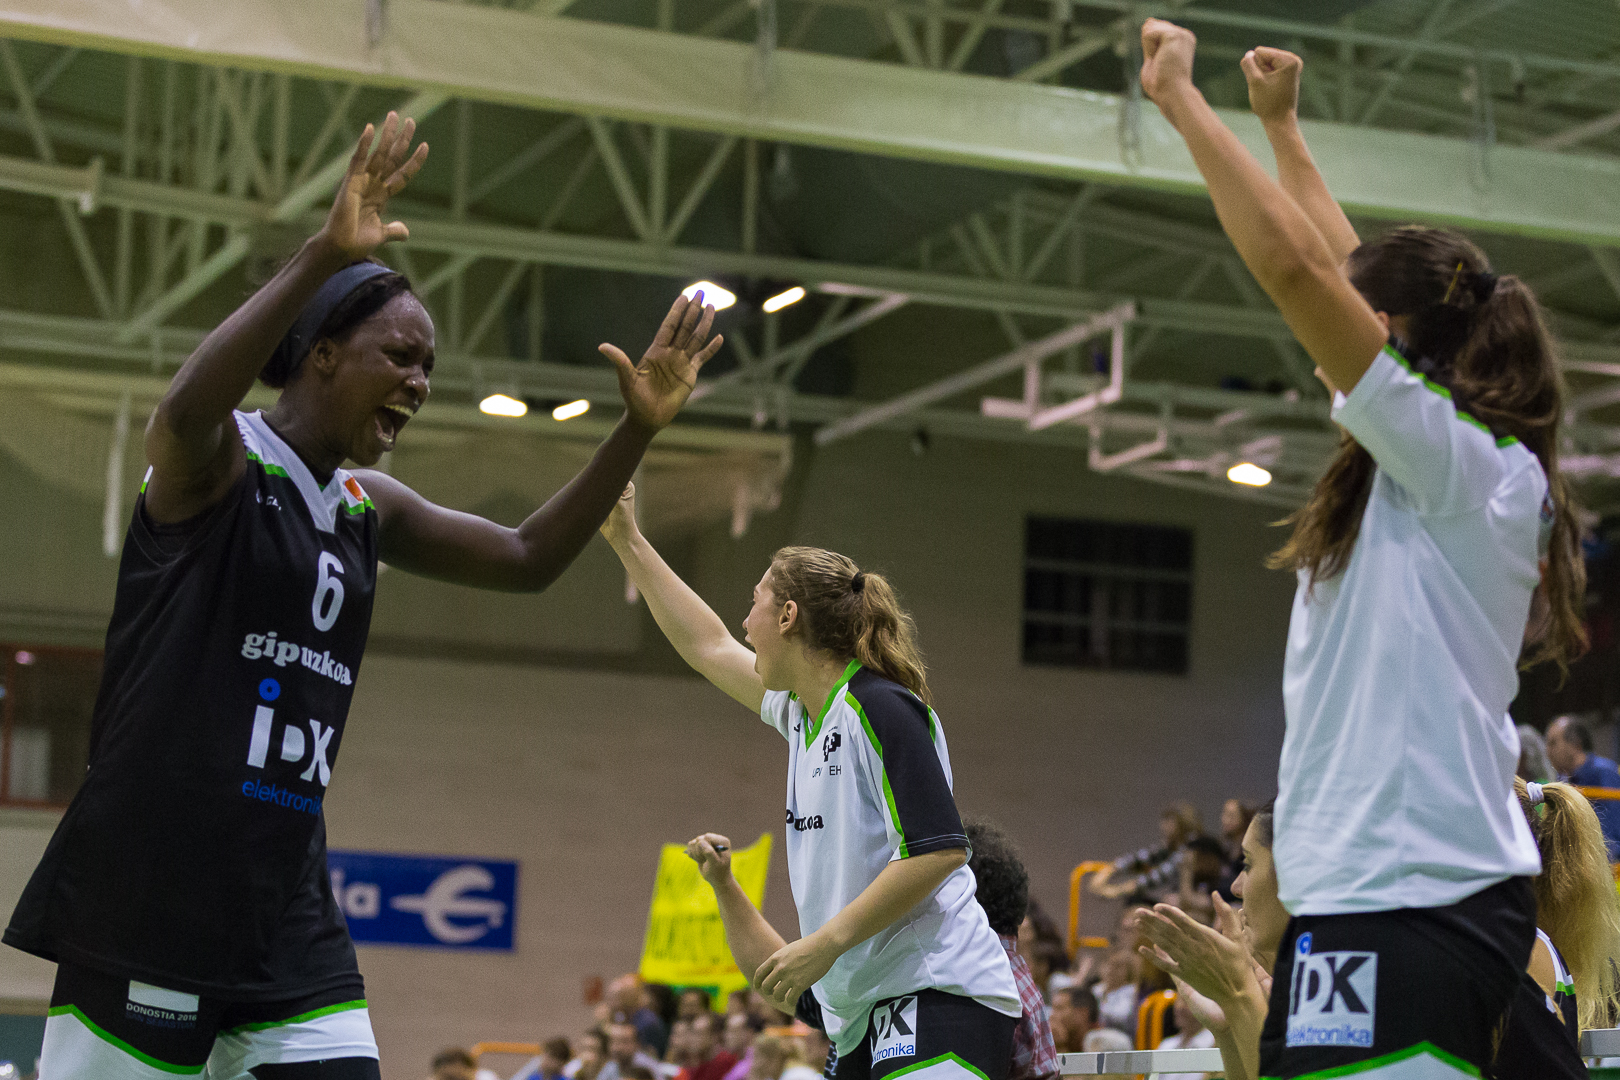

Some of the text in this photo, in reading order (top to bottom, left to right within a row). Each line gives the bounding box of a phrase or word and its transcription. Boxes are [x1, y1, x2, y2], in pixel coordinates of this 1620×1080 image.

[312, 550, 345, 632] 6
[241, 631, 353, 686] gipuzkoa
[126, 1002, 175, 1021] DONOSTIA
